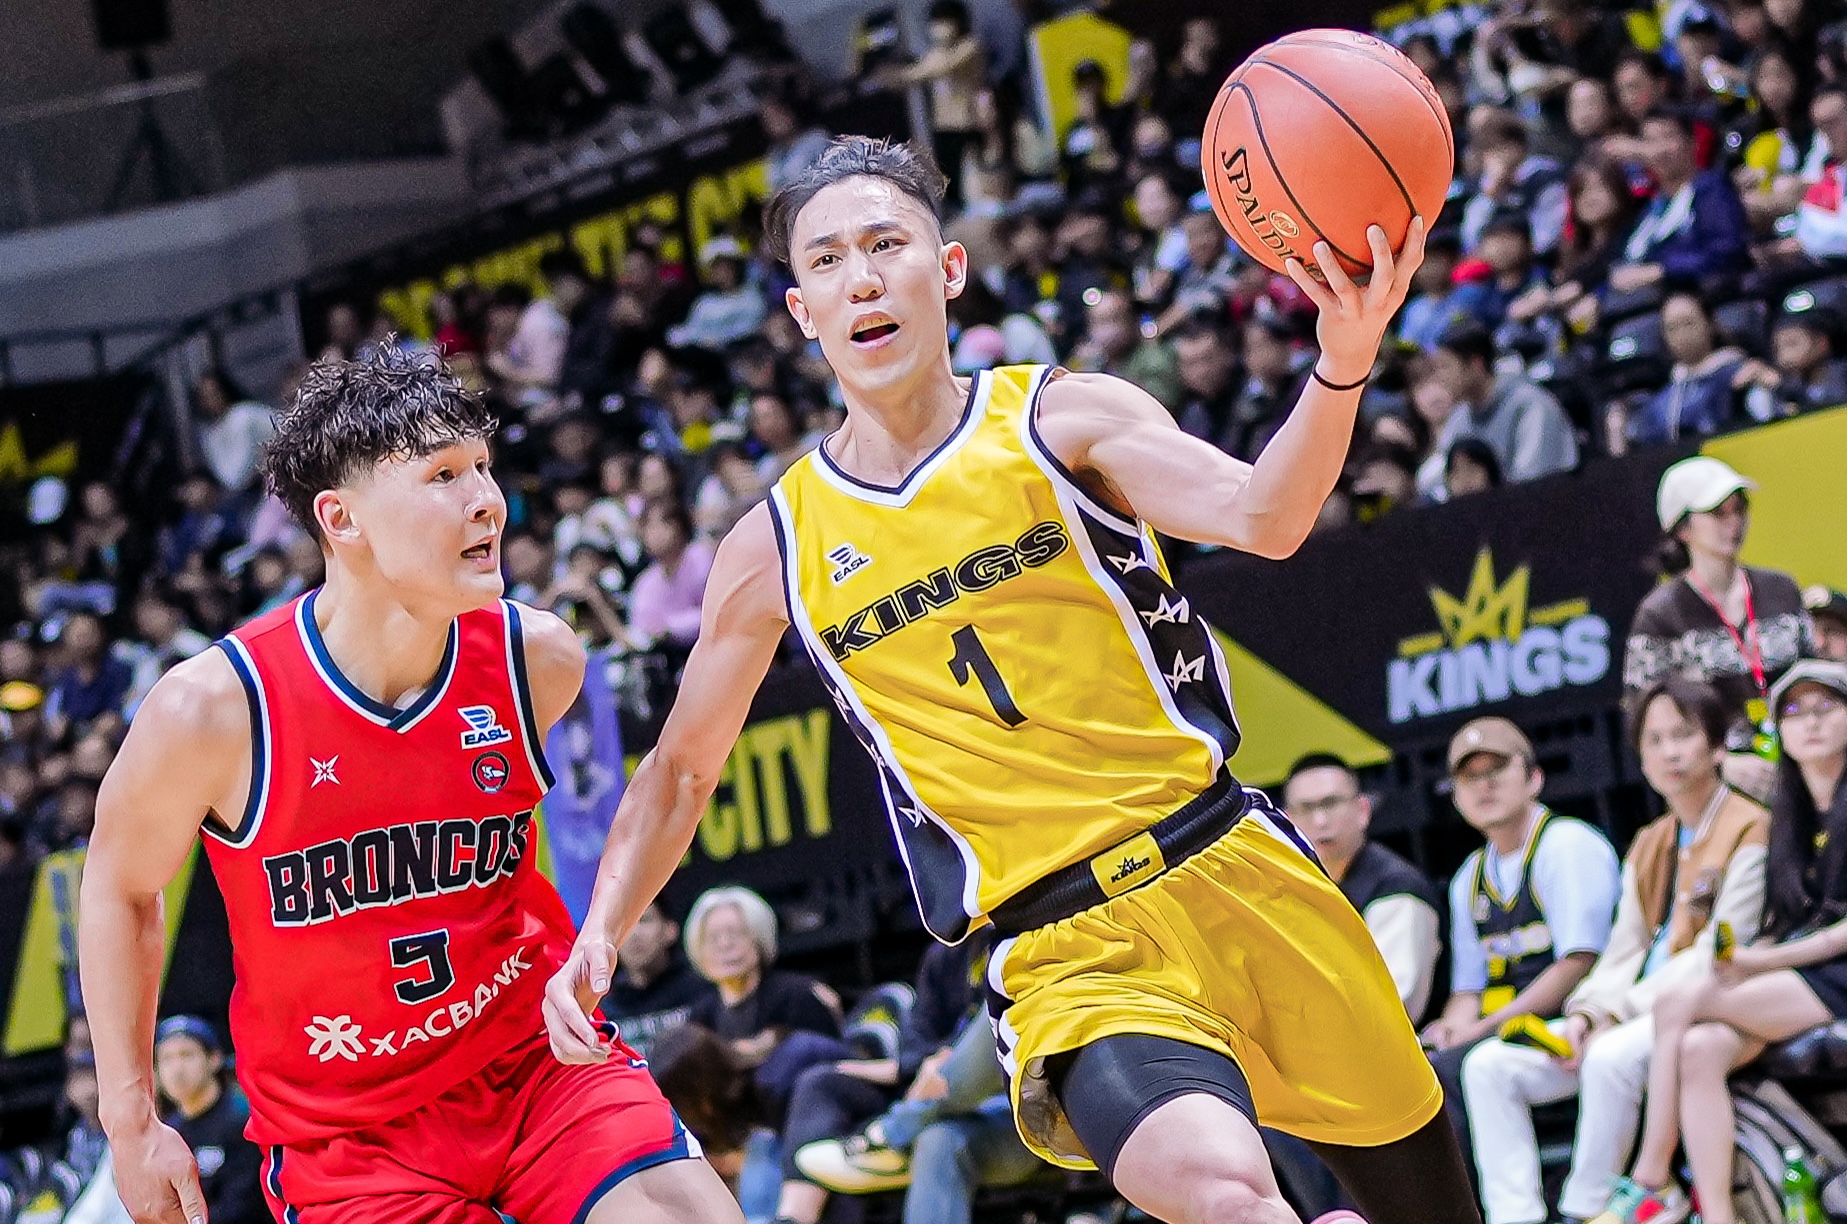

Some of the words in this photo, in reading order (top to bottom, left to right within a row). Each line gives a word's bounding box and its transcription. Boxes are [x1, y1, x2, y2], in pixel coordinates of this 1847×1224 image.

[819, 521, 1069, 662] KINGS
[833, 556, 870, 582] EASL
[948, 624, 1028, 727] 1
[1387, 614, 1611, 724] KINGS
[464, 727, 509, 746] EASL
[262, 810, 533, 927] BRONCOS
